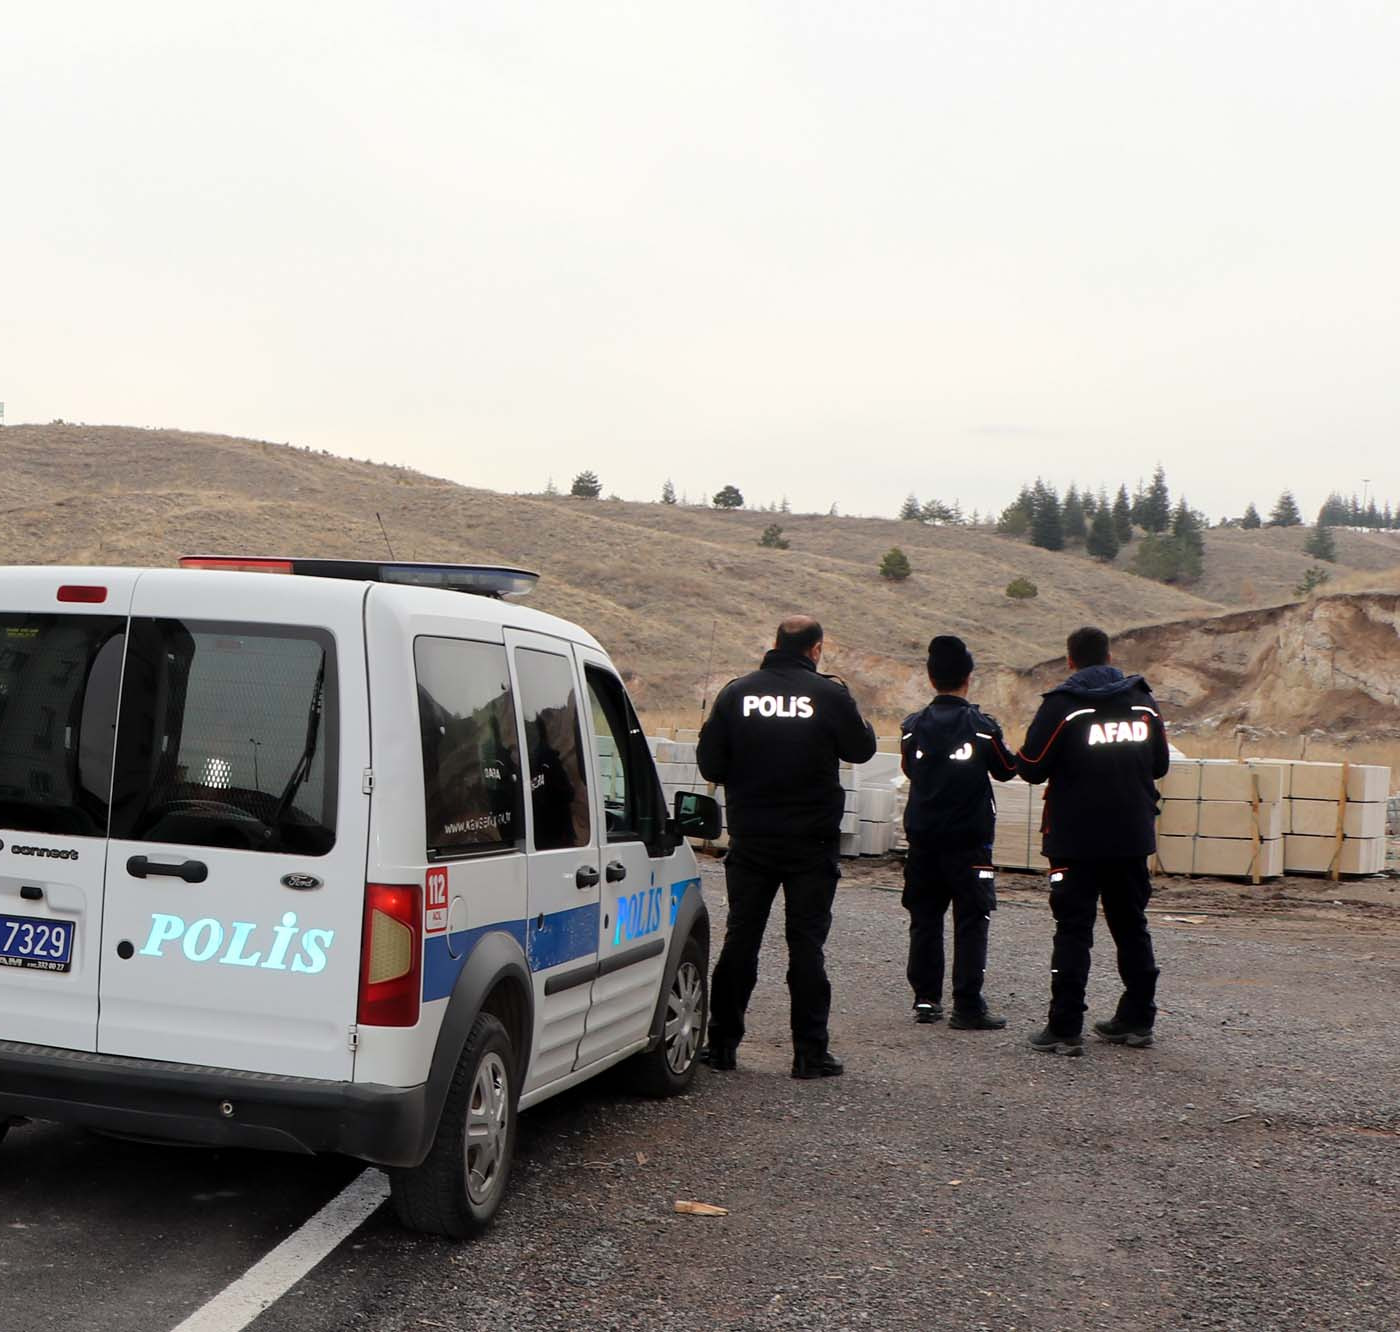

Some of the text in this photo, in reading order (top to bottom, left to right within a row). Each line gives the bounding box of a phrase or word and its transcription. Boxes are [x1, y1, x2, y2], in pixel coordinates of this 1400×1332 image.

[1088, 721, 1149, 746] AFAD
[429, 874, 446, 905] 112
[3, 921, 65, 958] 7329
[139, 911, 335, 974] POLİS
